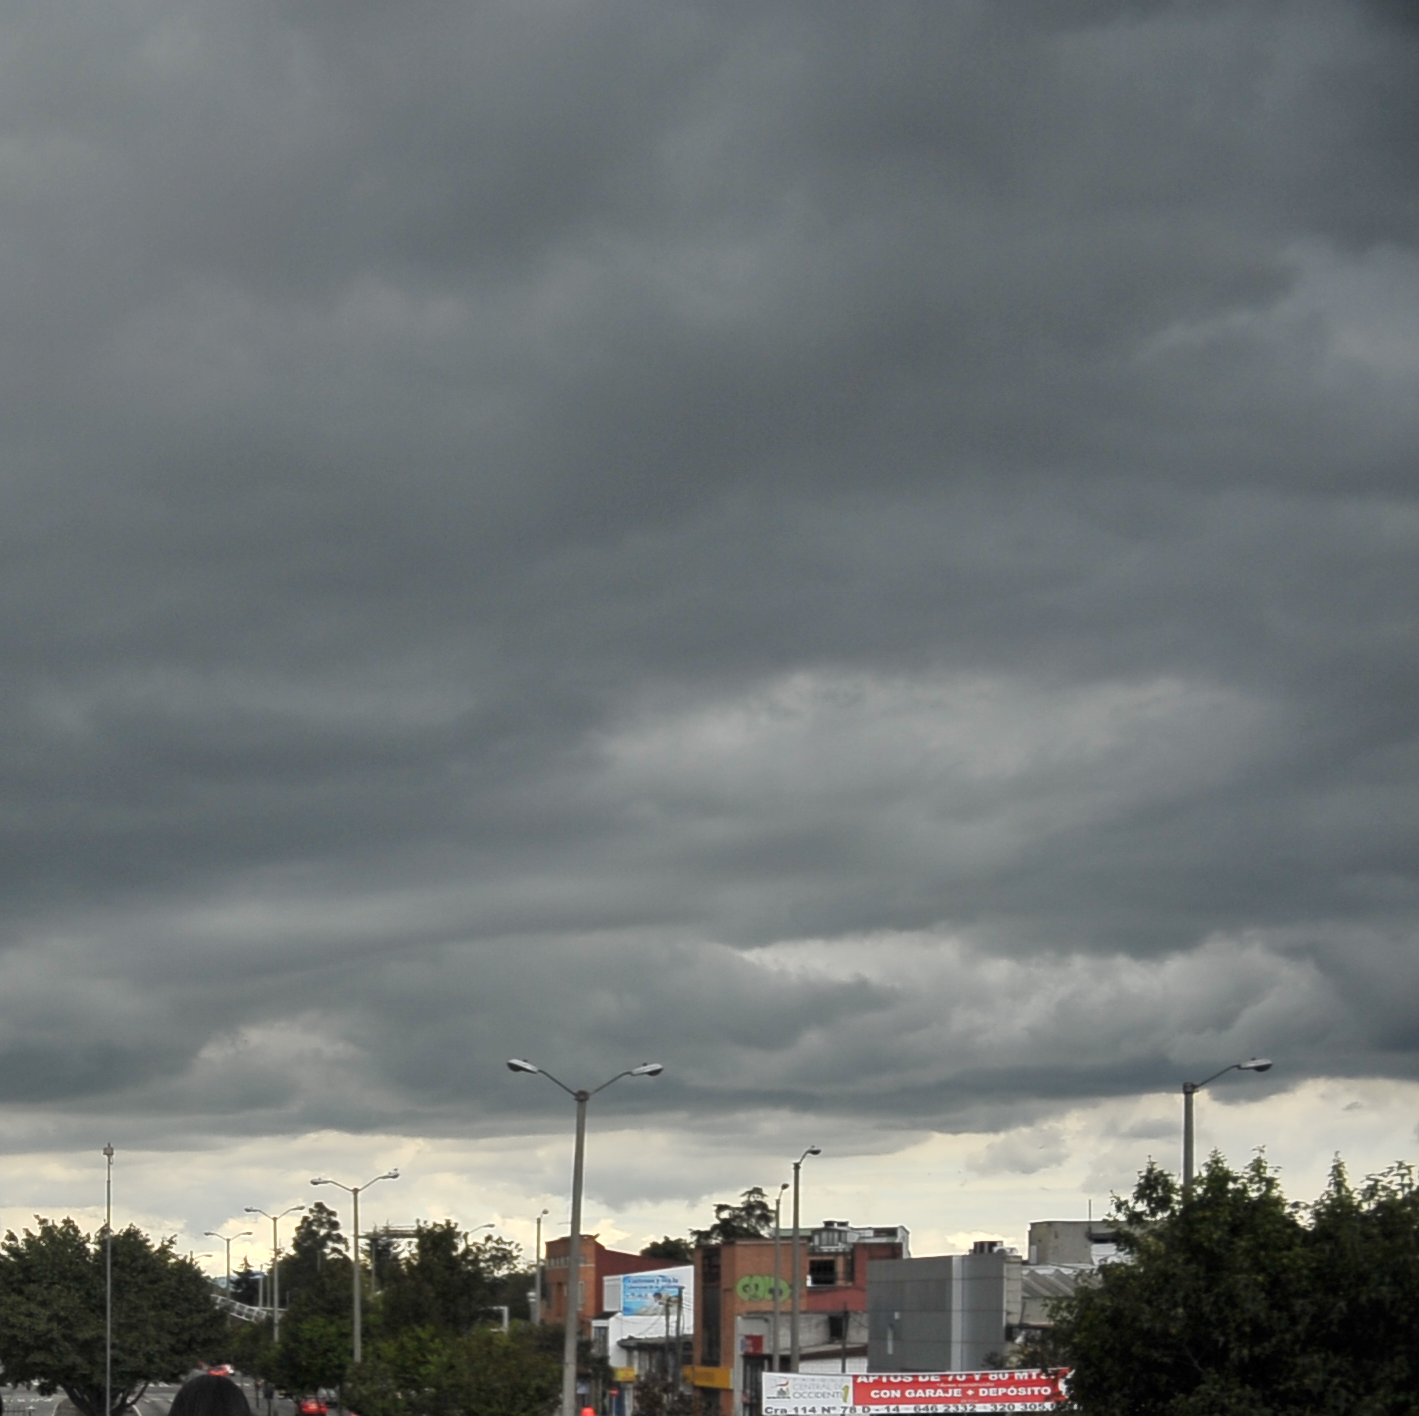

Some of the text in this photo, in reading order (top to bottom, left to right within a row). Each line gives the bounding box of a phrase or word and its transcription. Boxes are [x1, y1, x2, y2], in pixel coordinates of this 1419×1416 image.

[870, 1389, 901, 1398] CON
[905, 1387, 962, 1398] GARAJE
[978, 1385, 1052, 1397] DEPÓSITO
[764, 1406, 788, 1415] Cra
[793, 1406, 817, 1414] 114
[840, 1406, 857, 1414] 78
[861, 1405, 871, 1414] D
[989, 1403, 1016, 1412] 320
